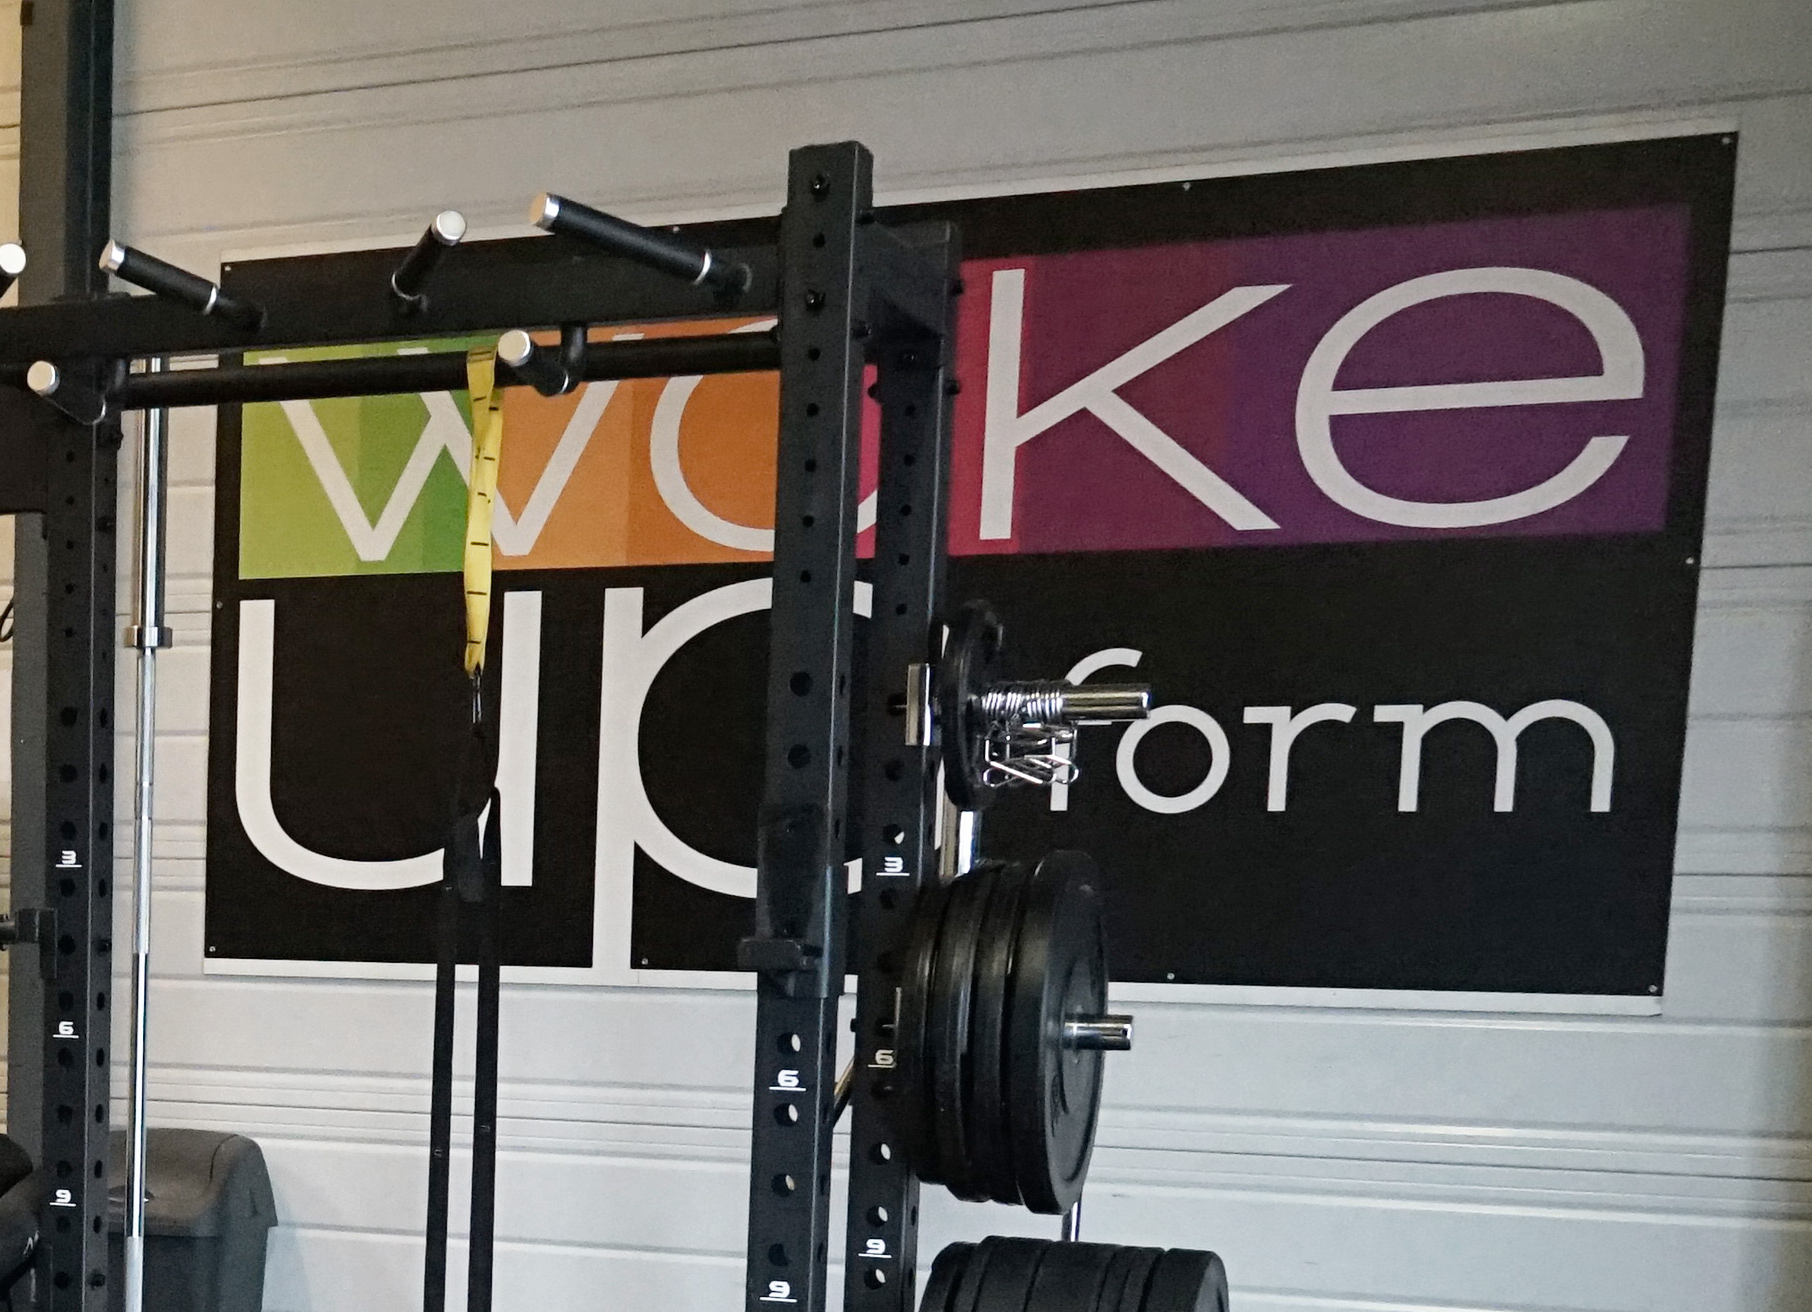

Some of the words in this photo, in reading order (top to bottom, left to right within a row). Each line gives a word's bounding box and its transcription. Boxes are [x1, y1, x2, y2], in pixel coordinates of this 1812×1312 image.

[884, 856, 904, 873] 3
[778, 1069, 799, 1087] 6
[866, 1238, 886, 1254] 9
[769, 1280, 790, 1298] 9
